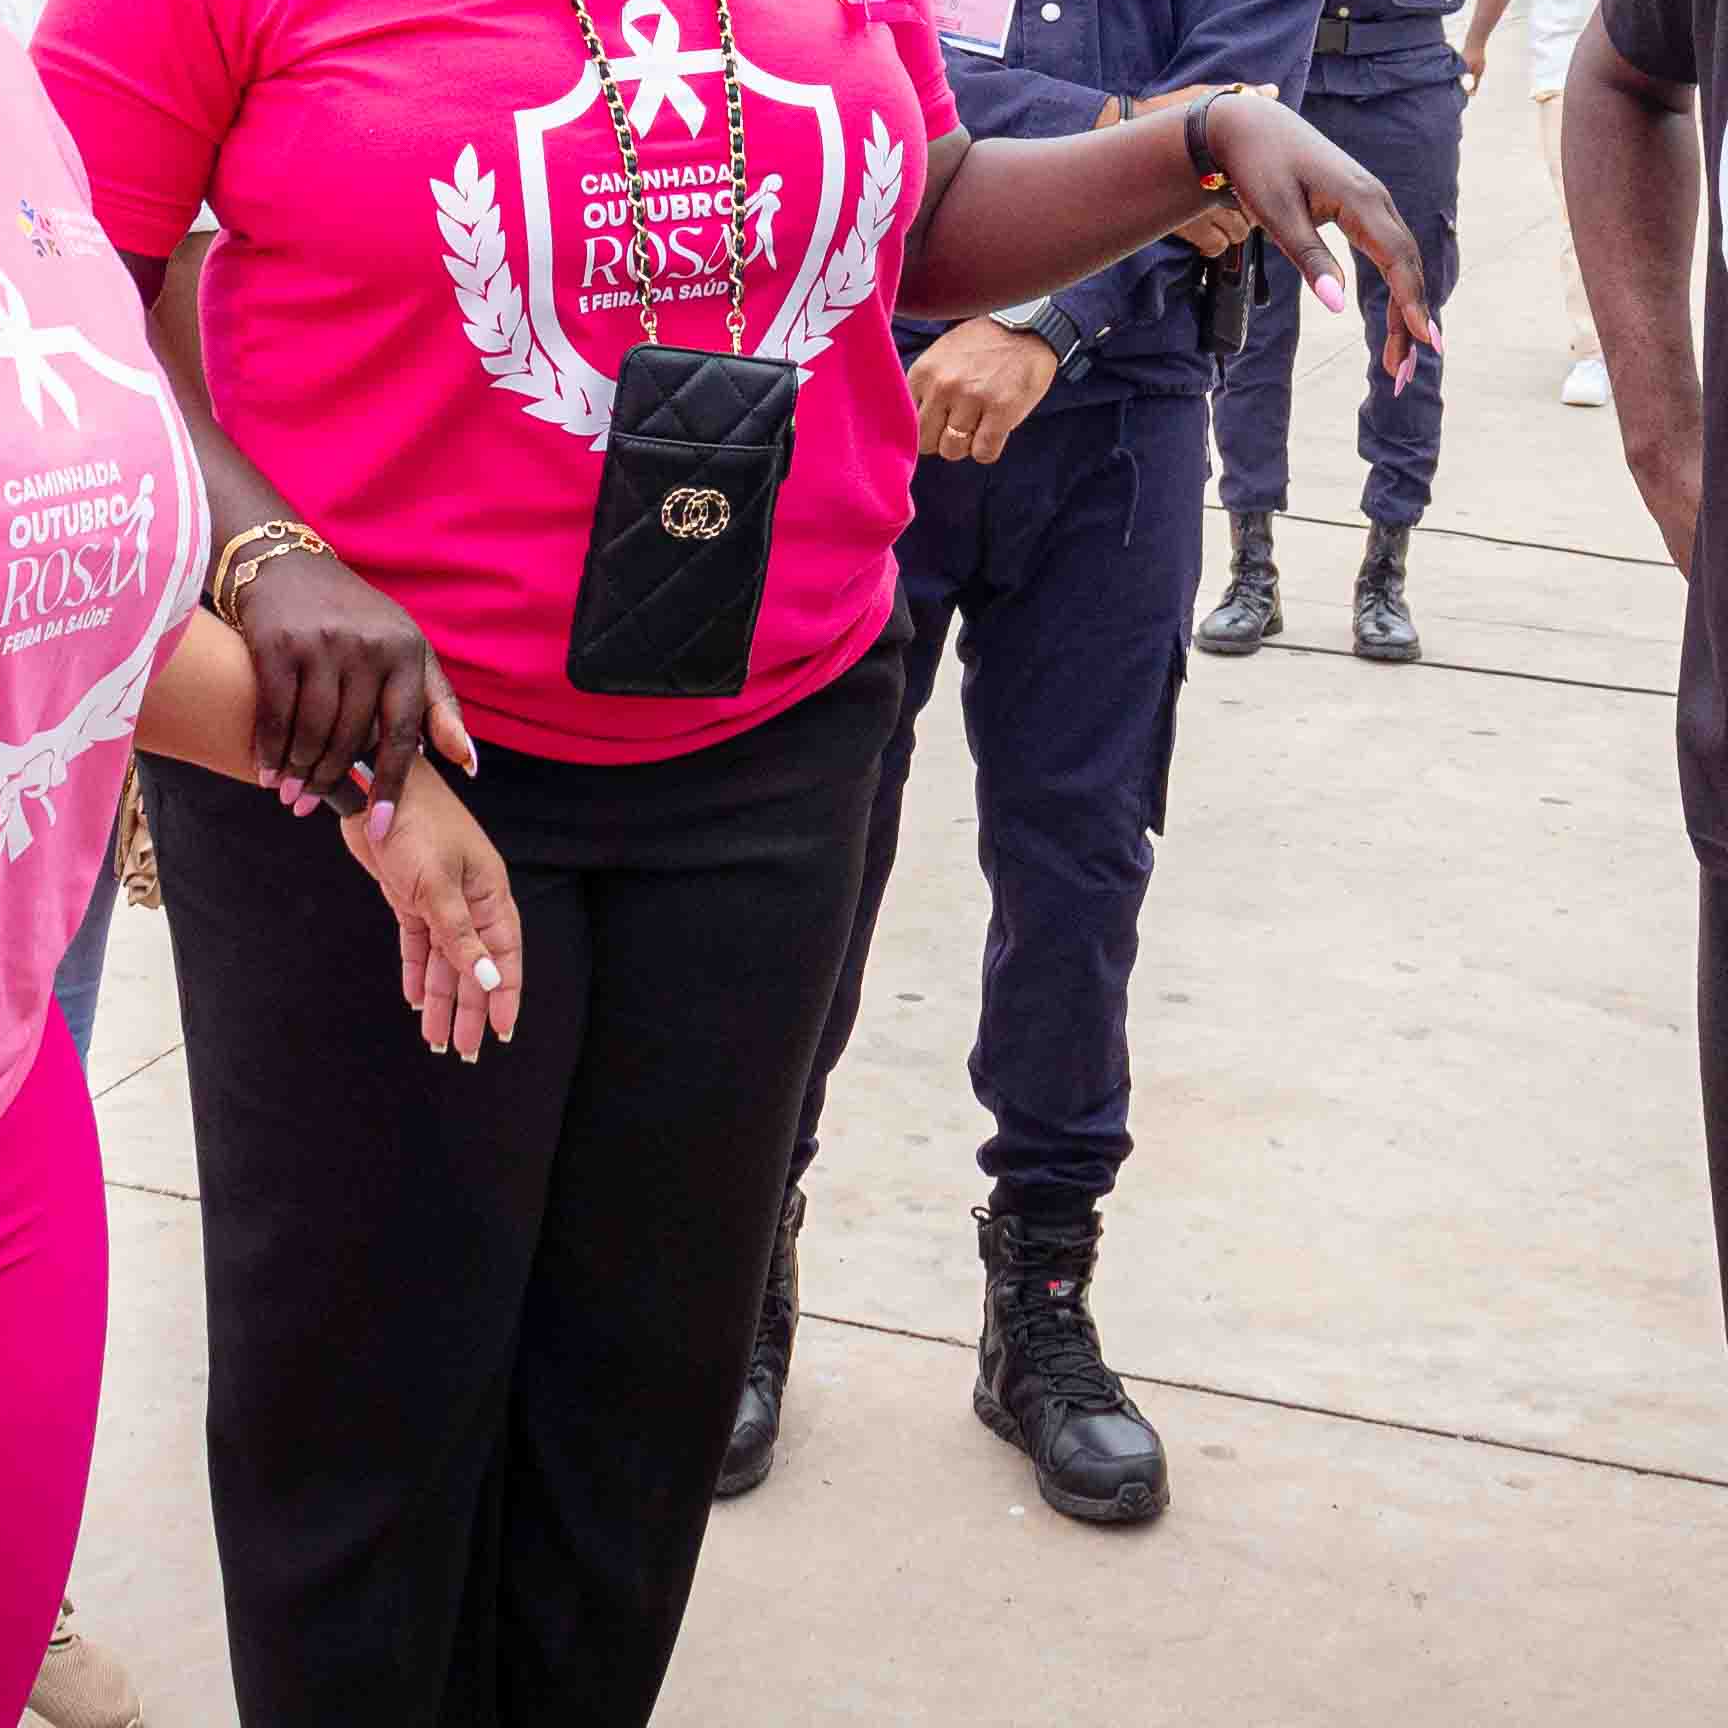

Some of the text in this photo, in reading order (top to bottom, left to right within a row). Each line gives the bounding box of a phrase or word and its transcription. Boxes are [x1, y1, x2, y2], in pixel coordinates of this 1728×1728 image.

[580, 163, 735, 196] CAMNHADA
[582, 189, 736, 229] OUUBRO
[579, 295, 589, 314] E
[591, 291, 644, 312] FEIRA
[678, 278, 731, 300] SAÚD
[3, 458, 122, 506] CAMINHADA
[9, 493, 128, 550] OUTUBRO
[0, 536, 132, 628] ROSA
[2, 623, 42, 656] FEIRA
[44, 616, 63, 641] DA
[64, 605, 114, 635] SAÚDE
